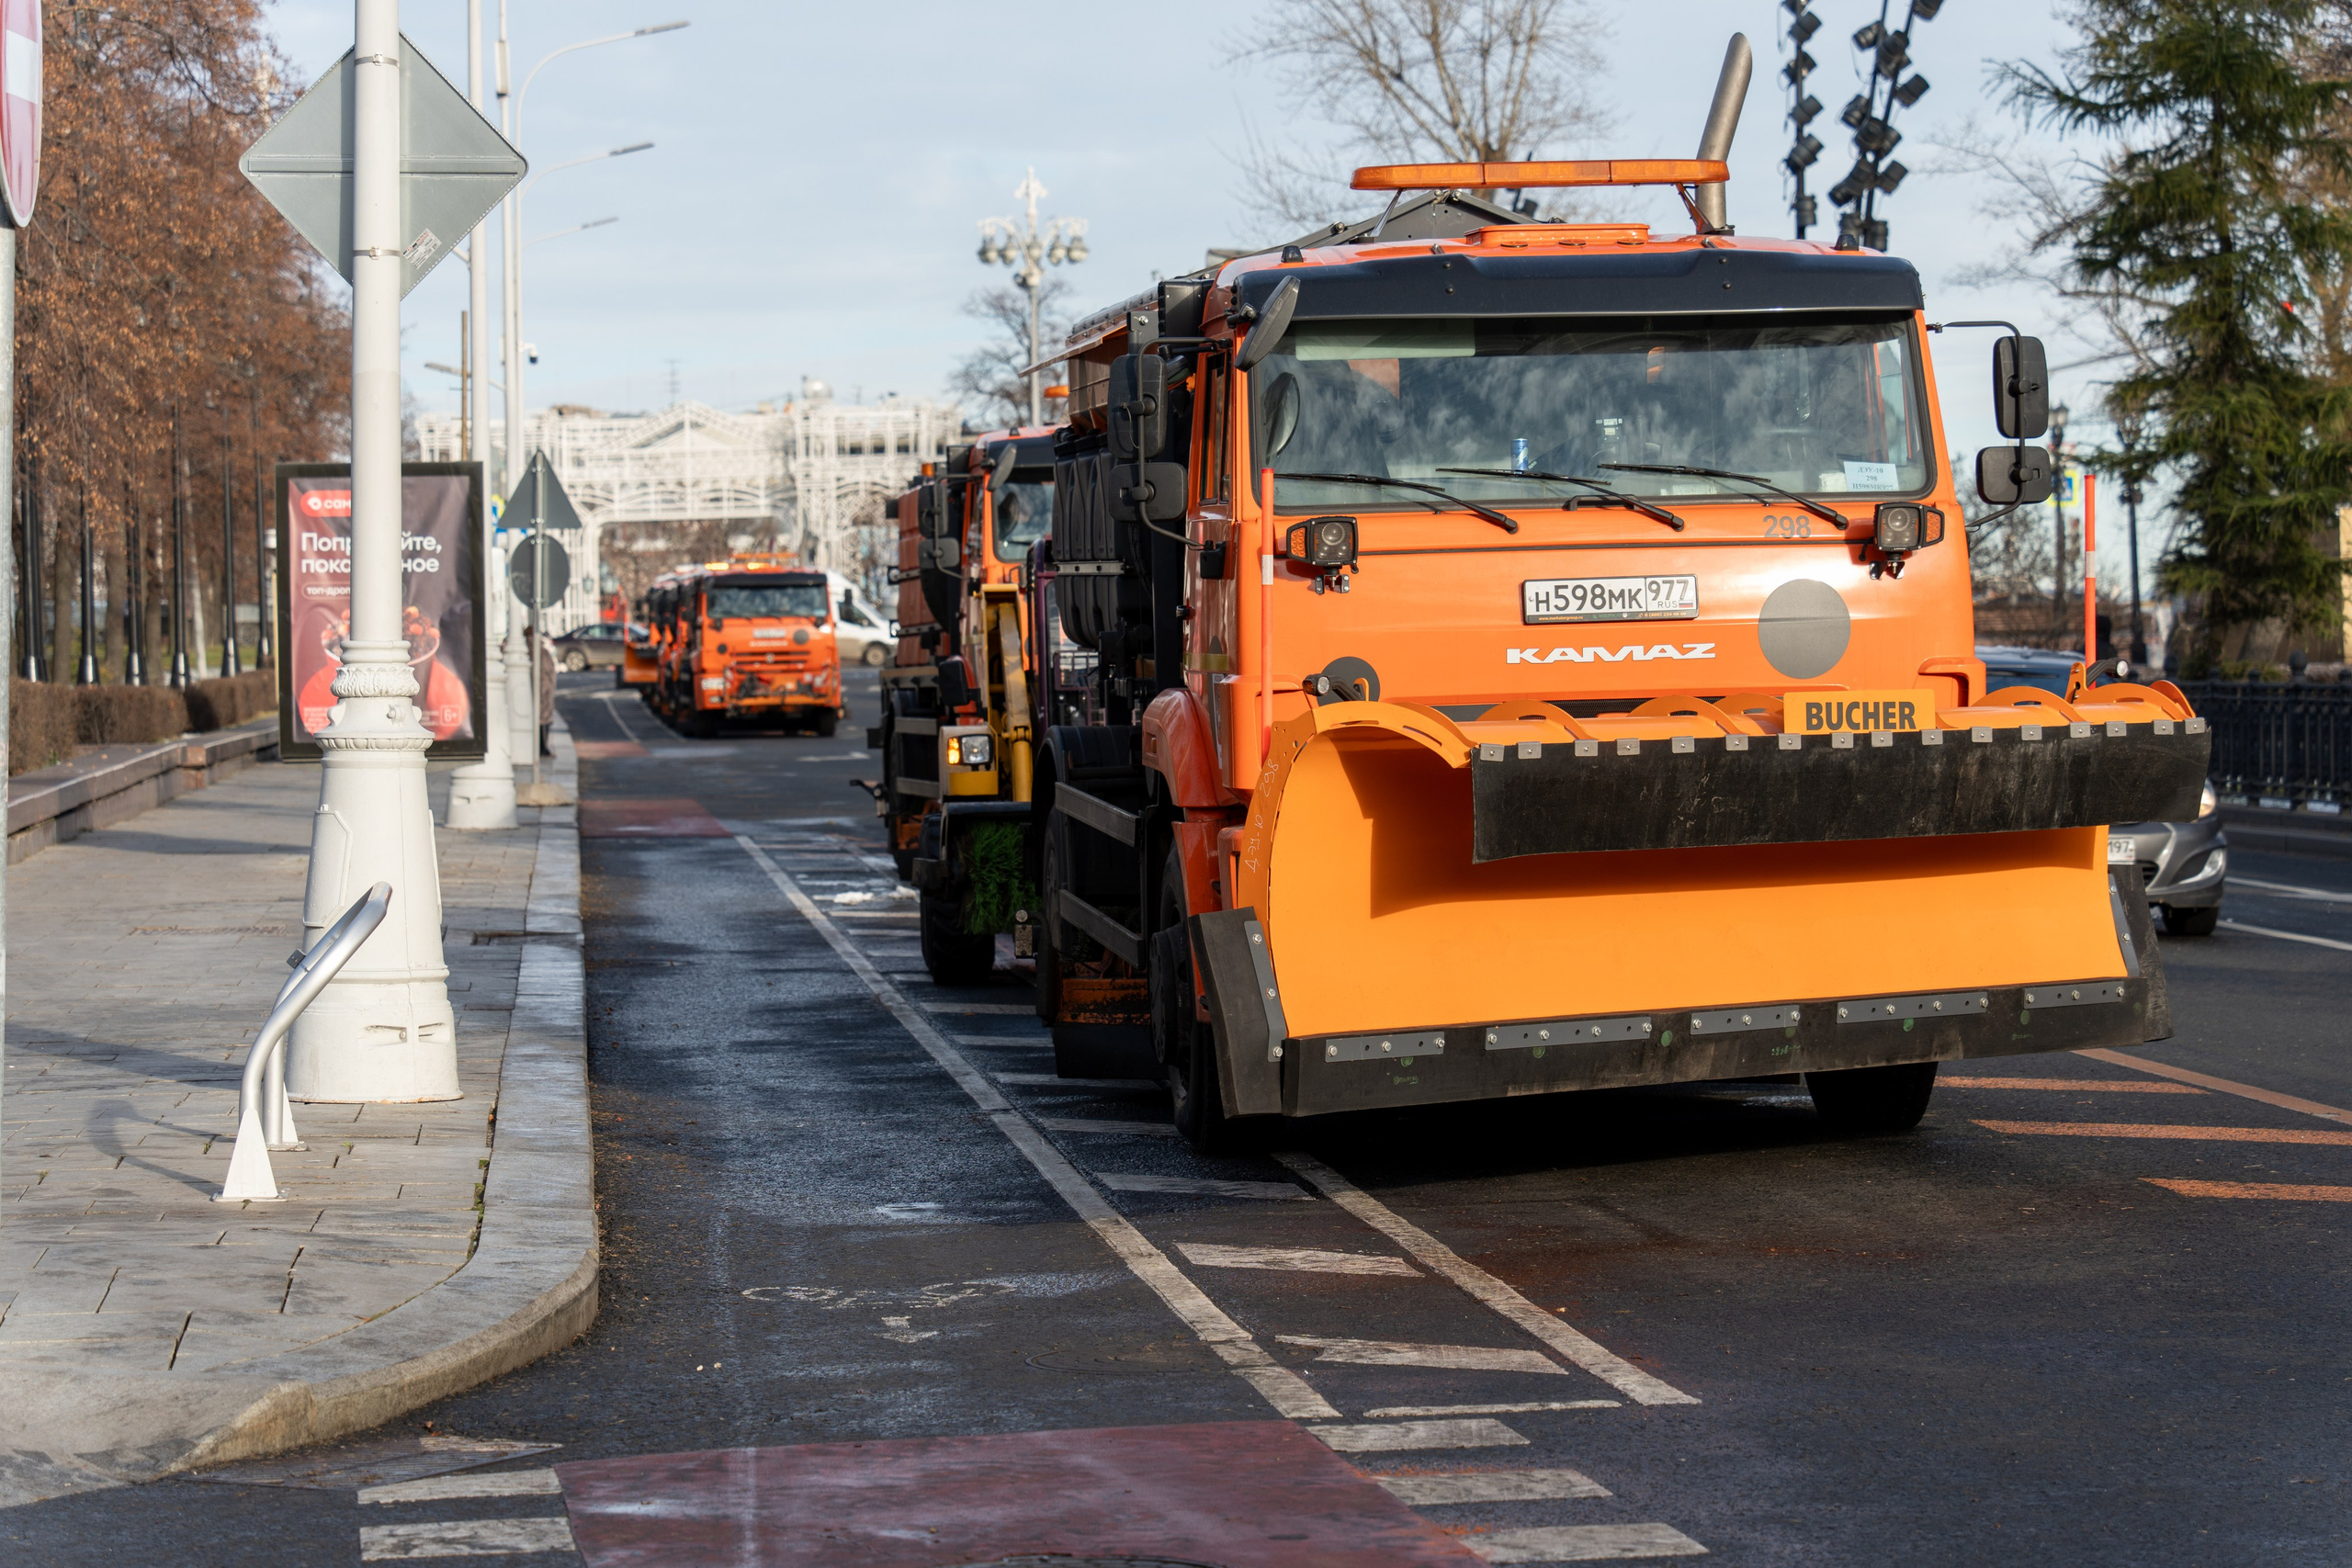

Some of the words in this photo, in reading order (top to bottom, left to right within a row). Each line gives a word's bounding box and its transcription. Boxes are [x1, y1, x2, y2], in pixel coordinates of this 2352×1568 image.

[1763, 515, 1811, 538] 298
[1535, 583, 1643, 612] Н598МК
[1647, 580, 1689, 601] 977
[1507, 643, 1715, 664] KAMAZ
[444, 707, 458, 723] 6+
[1806, 702, 1917, 730] BUCHER
[1260, 758, 1279, 797] 298
